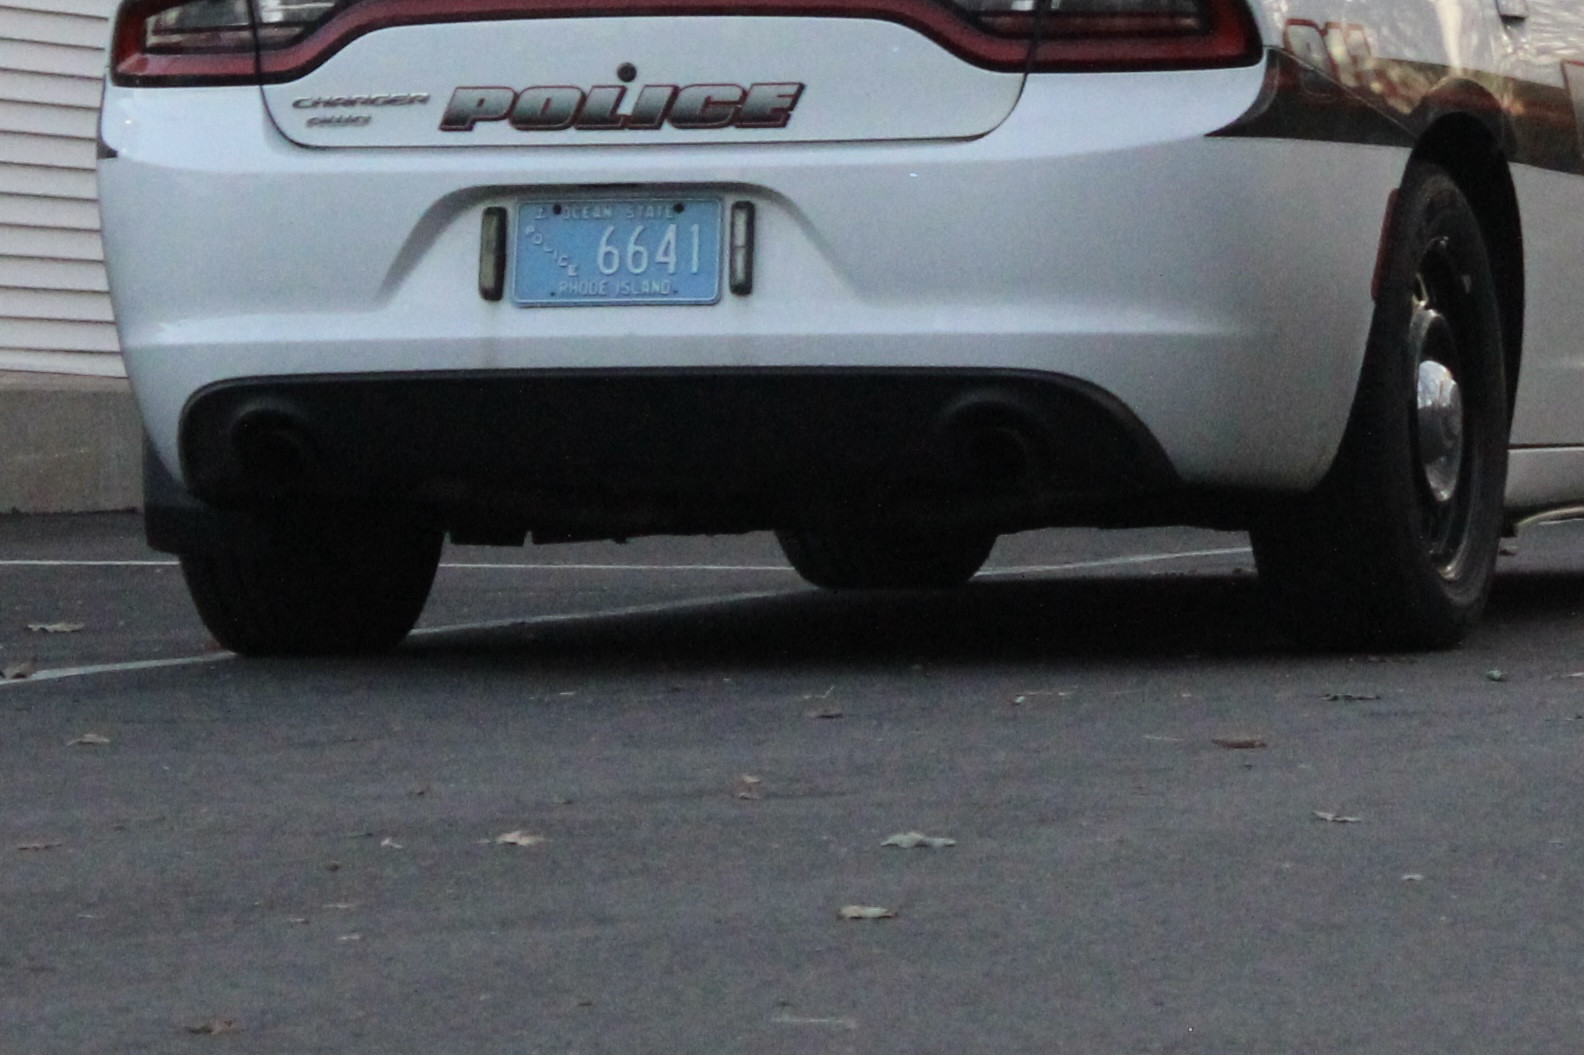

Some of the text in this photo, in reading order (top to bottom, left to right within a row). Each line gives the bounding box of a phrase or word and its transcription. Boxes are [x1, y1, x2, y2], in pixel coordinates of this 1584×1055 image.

[438, 82, 806, 131] POLICE
[563, 205, 675, 221] OCEAN STATE
[525, 225, 579, 278] POLICE
[598, 223, 701, 276] 6641
[559, 279, 672, 296] RHODE ISLAND
